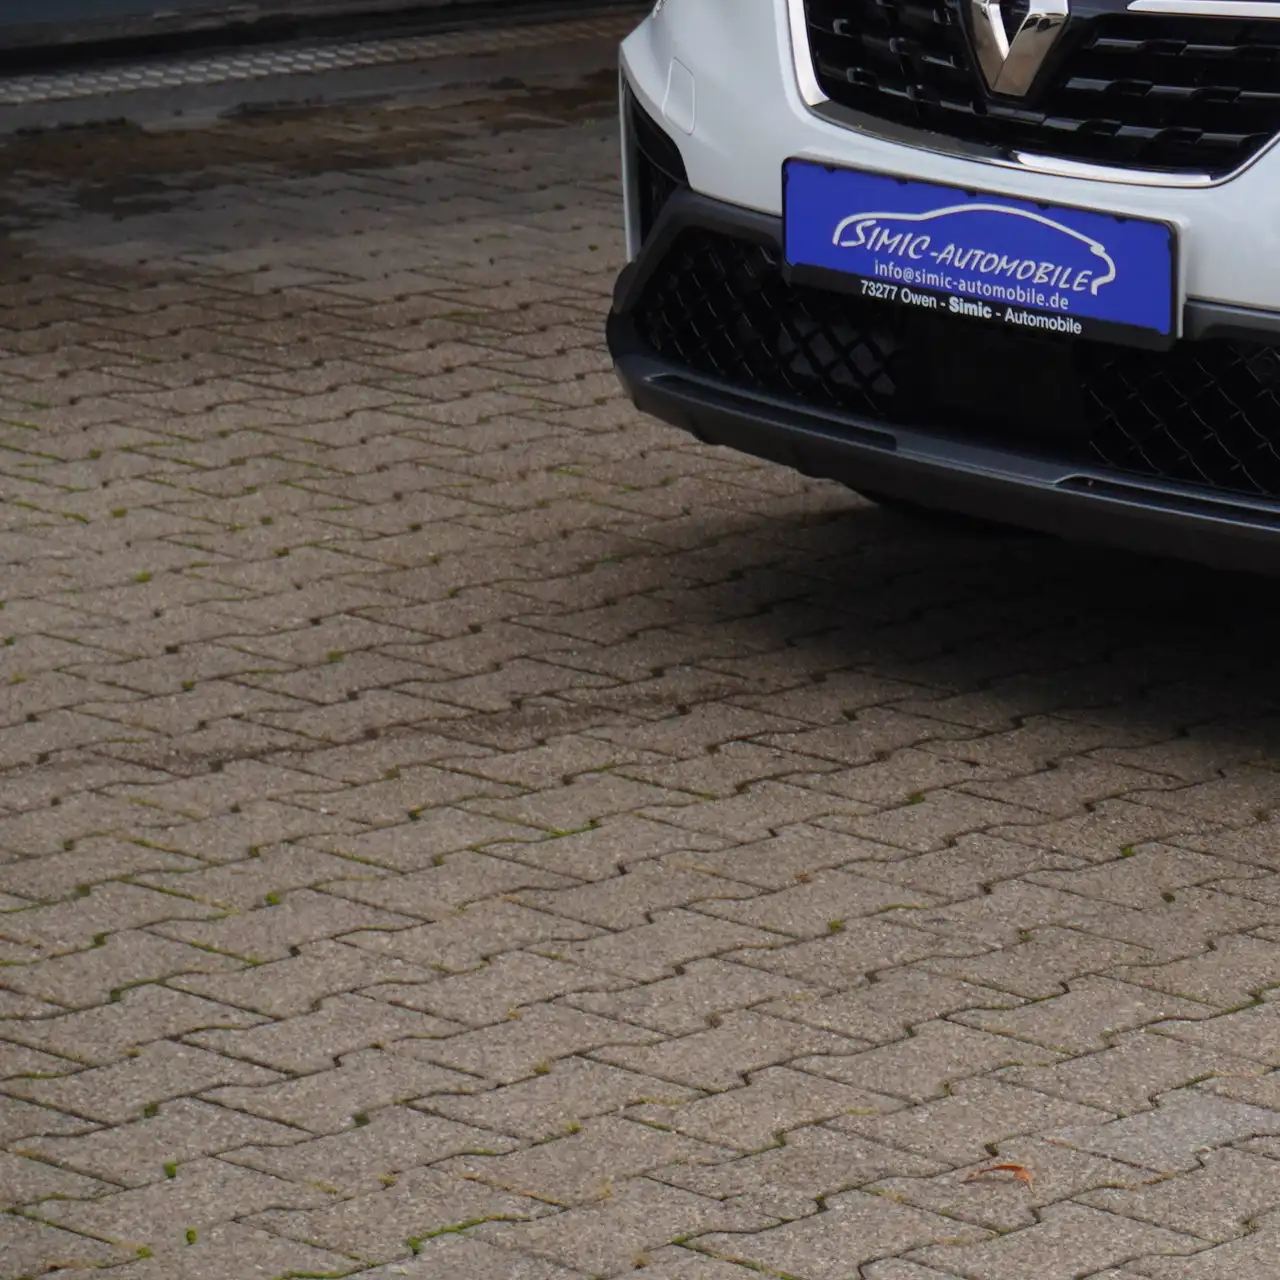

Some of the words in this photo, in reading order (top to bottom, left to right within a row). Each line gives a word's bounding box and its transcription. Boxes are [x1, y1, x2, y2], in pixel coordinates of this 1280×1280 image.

[860, 279, 899, 301] 73277
[901, 287, 938, 309] Owen
[948, 295, 993, 319] Simic
[1004, 307, 1082, 334] Automobile
[874, 259, 1069, 310] info@simic-automobile.de
